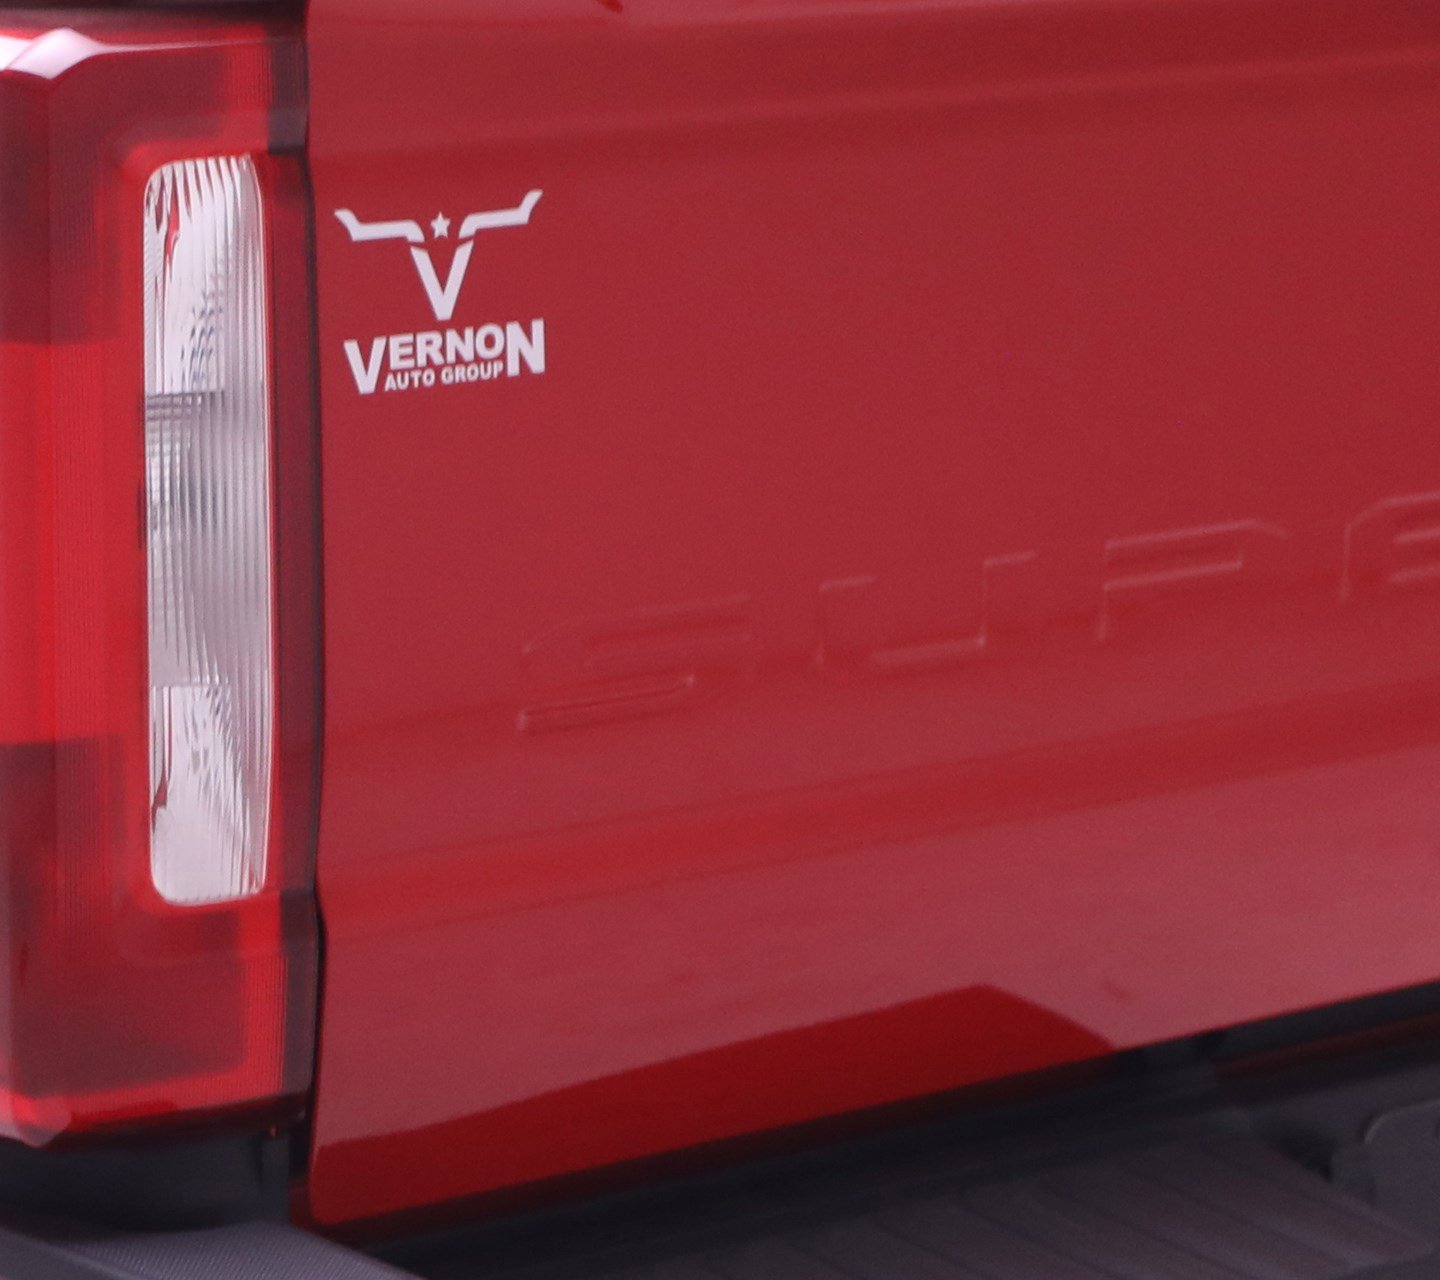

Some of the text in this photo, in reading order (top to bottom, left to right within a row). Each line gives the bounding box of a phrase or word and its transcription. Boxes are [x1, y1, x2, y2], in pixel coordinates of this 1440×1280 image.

[344, 318, 545, 394] VERNON
[384, 361, 505, 393] AUTO GROUP
